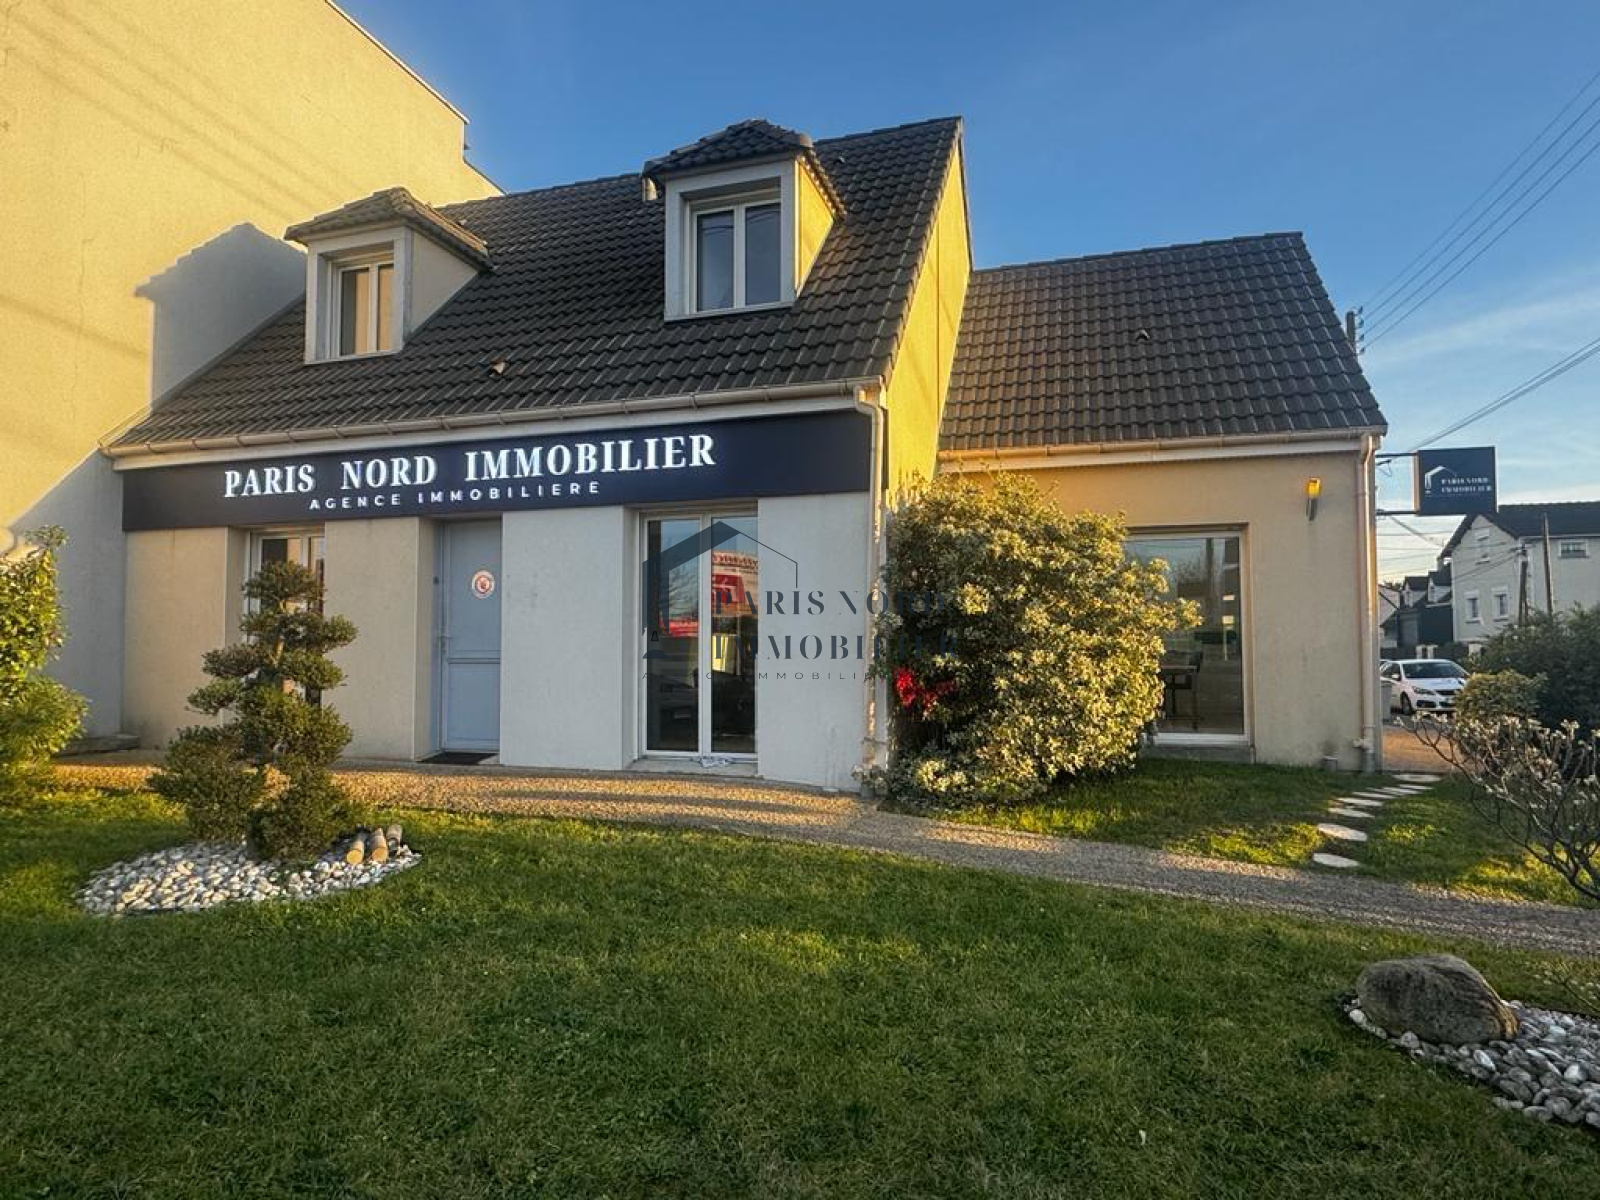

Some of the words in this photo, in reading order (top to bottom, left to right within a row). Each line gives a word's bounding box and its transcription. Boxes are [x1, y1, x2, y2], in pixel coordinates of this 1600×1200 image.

[224, 463, 315, 498] PARIS
[340, 455, 436, 490] NORD
[464, 434, 716, 482] IMMOBILIER
[309, 493, 400, 510] AGENCE
[418, 481, 600, 503] IMMOBILIERE
